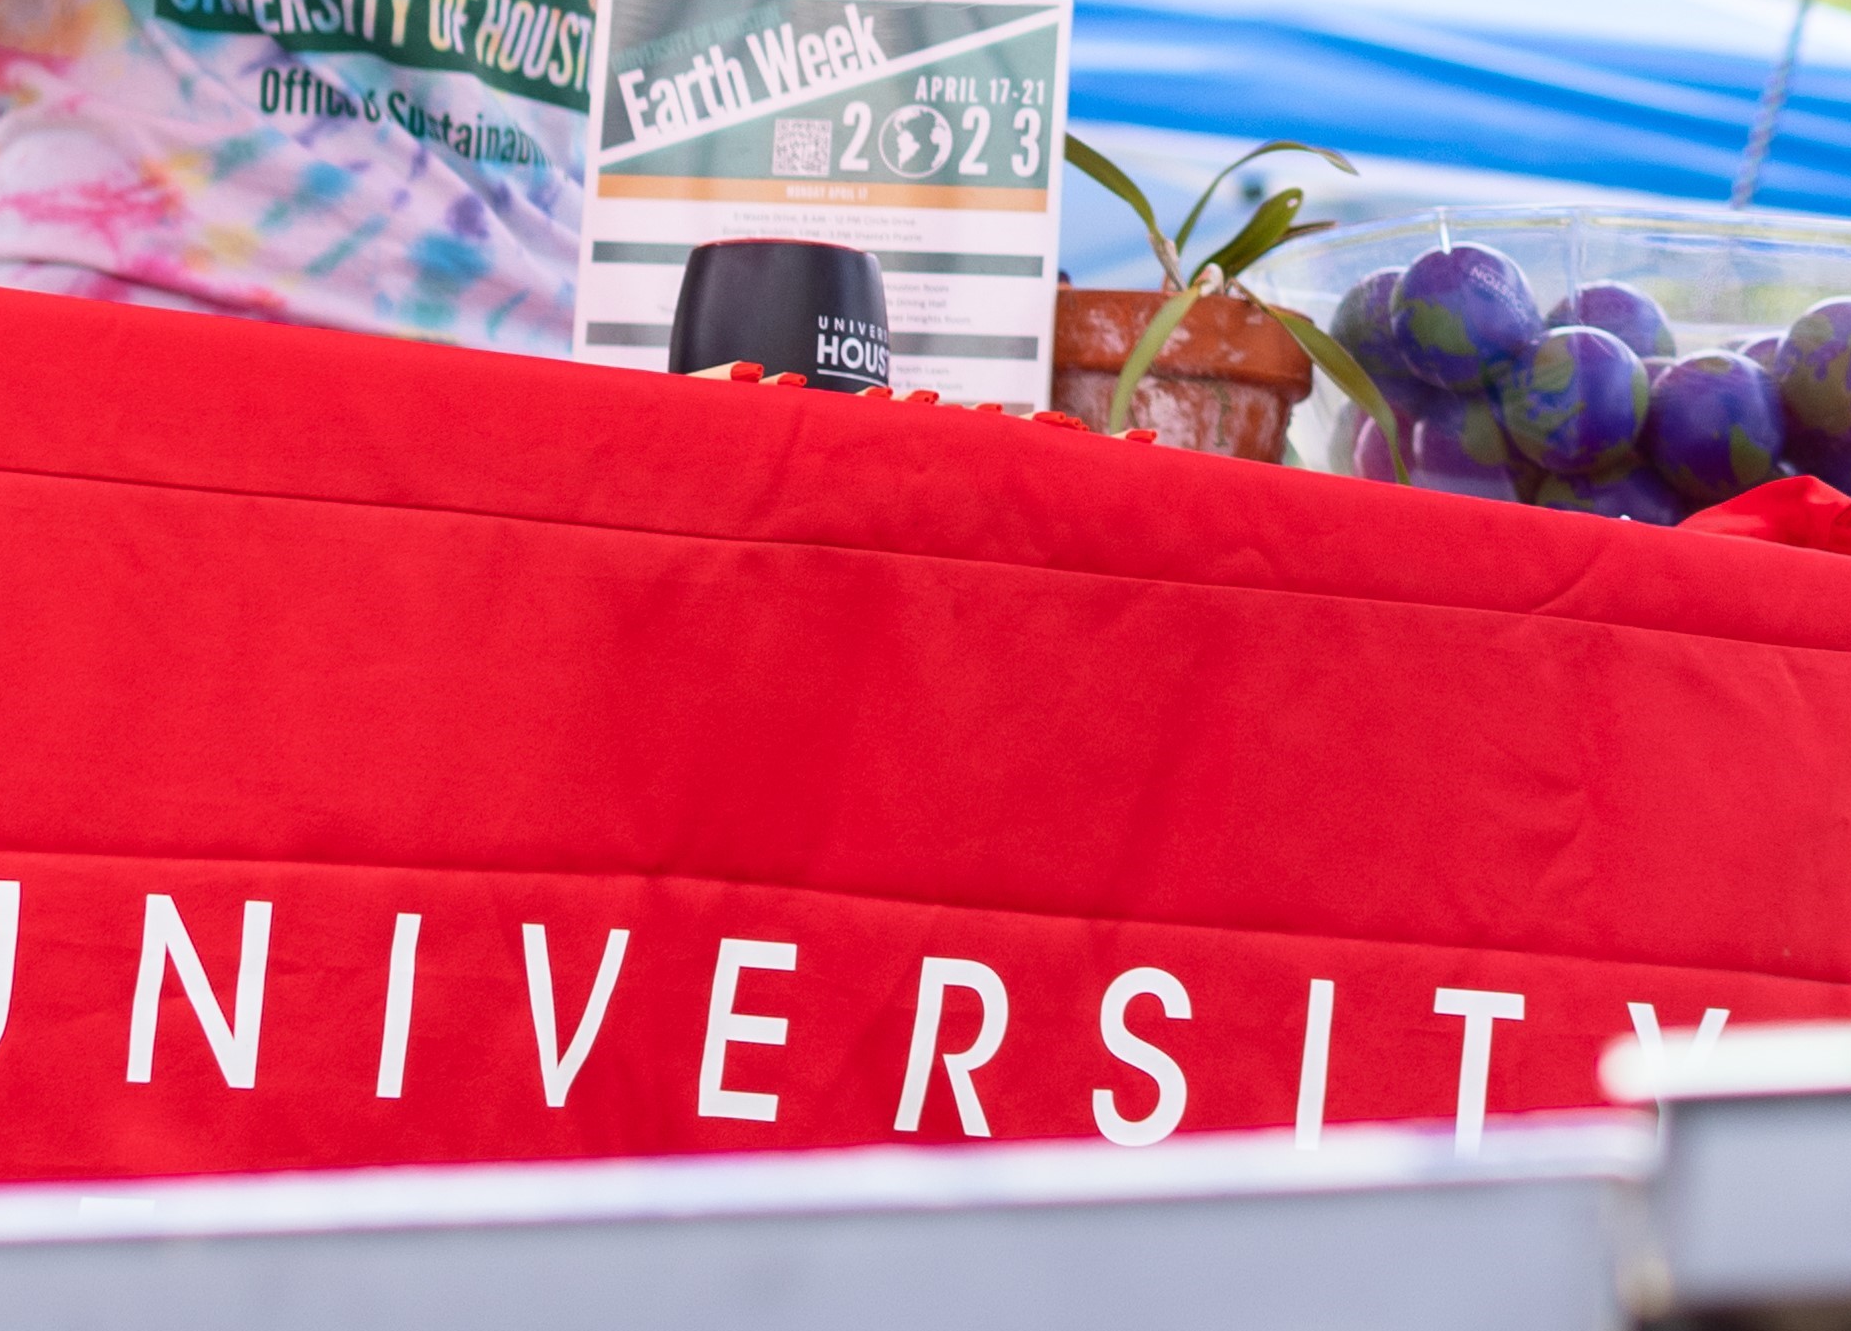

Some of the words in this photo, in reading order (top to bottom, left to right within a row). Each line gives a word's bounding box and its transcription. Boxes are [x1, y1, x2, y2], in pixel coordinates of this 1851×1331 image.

[617, 44, 751, 141] Earth
[746, 3, 888, 100] Week
[915, 76, 978, 104] APRIL
[990, 78, 1046, 106] 17-21
[817, 334, 890, 378] HOUS
